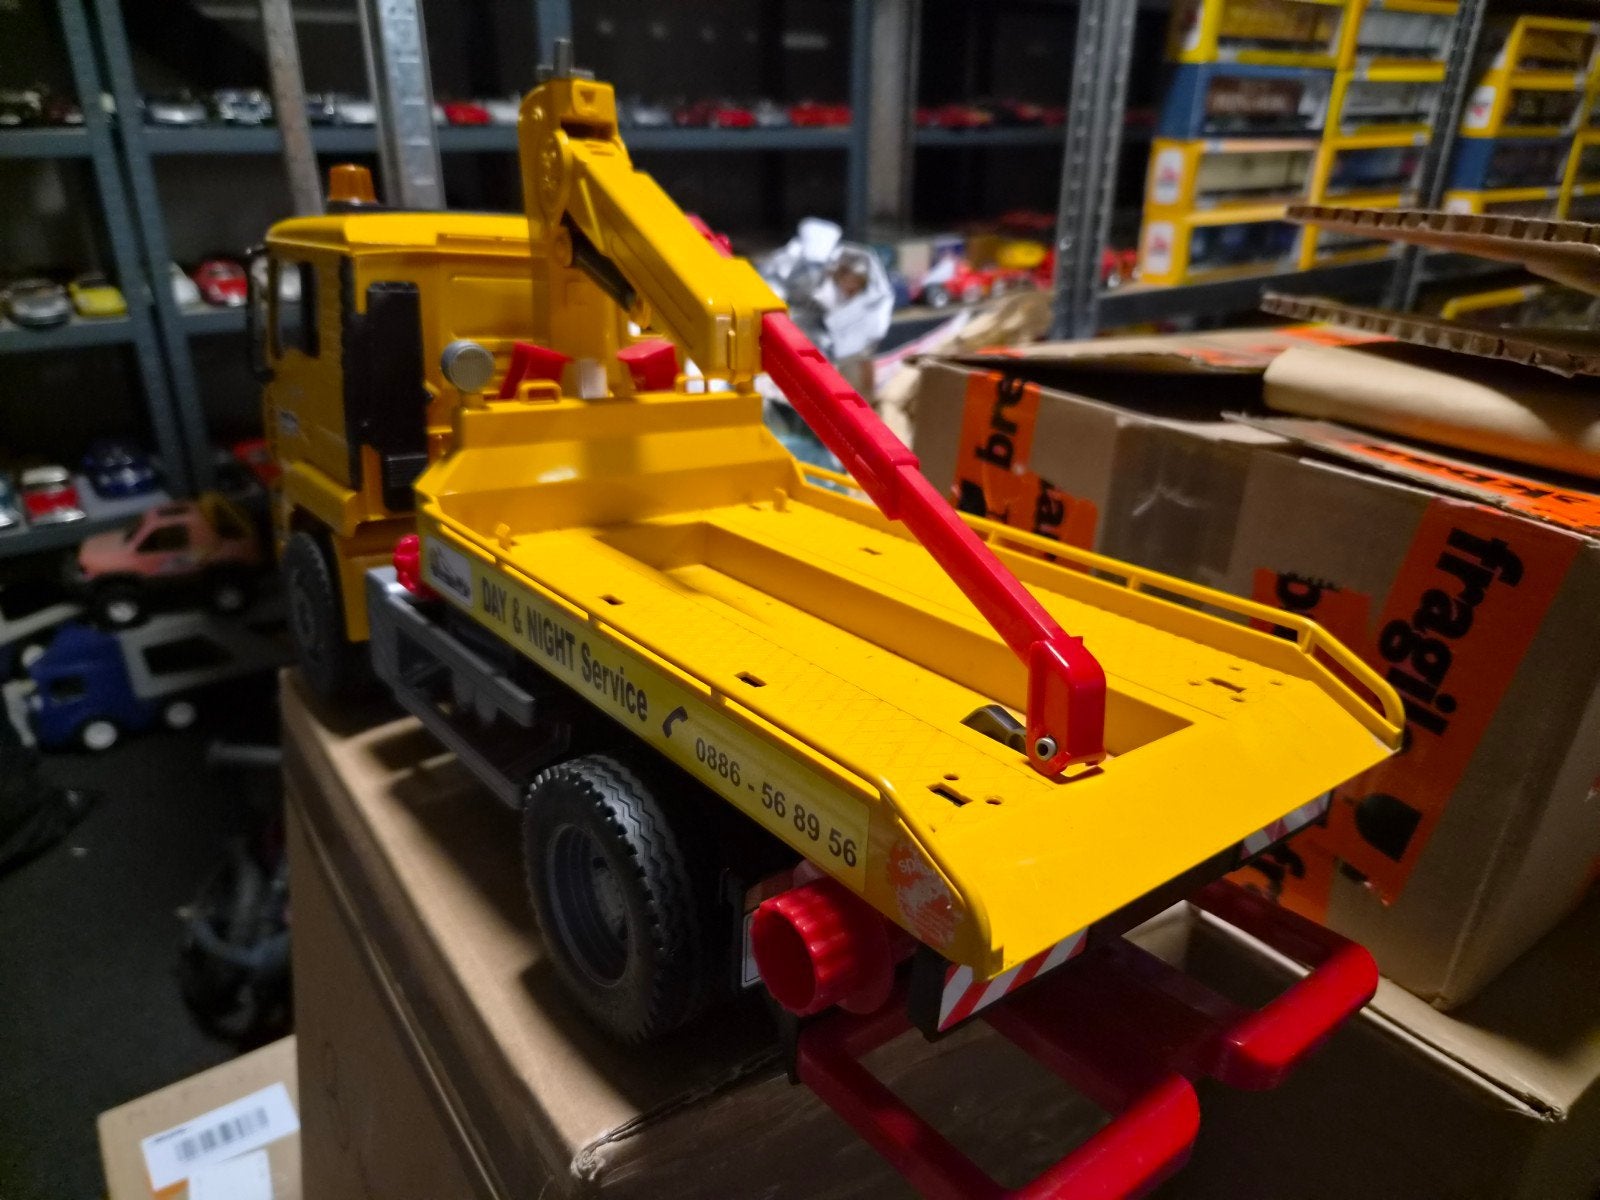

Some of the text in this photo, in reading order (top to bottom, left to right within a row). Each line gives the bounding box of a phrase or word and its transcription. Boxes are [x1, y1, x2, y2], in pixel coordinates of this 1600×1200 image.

[481, 576, 507, 624] DAY
[512, 597, 523, 635] &
[526, 605, 576, 671] NIGHT
[581, 642, 648, 722] Service
[695, 737, 741, 787] 0886
[761, 781, 786, 818] 56
[793, 803, 820, 842] 89
[828, 827, 857, 867] 56
[1378, 527, 1524, 750] fragil
